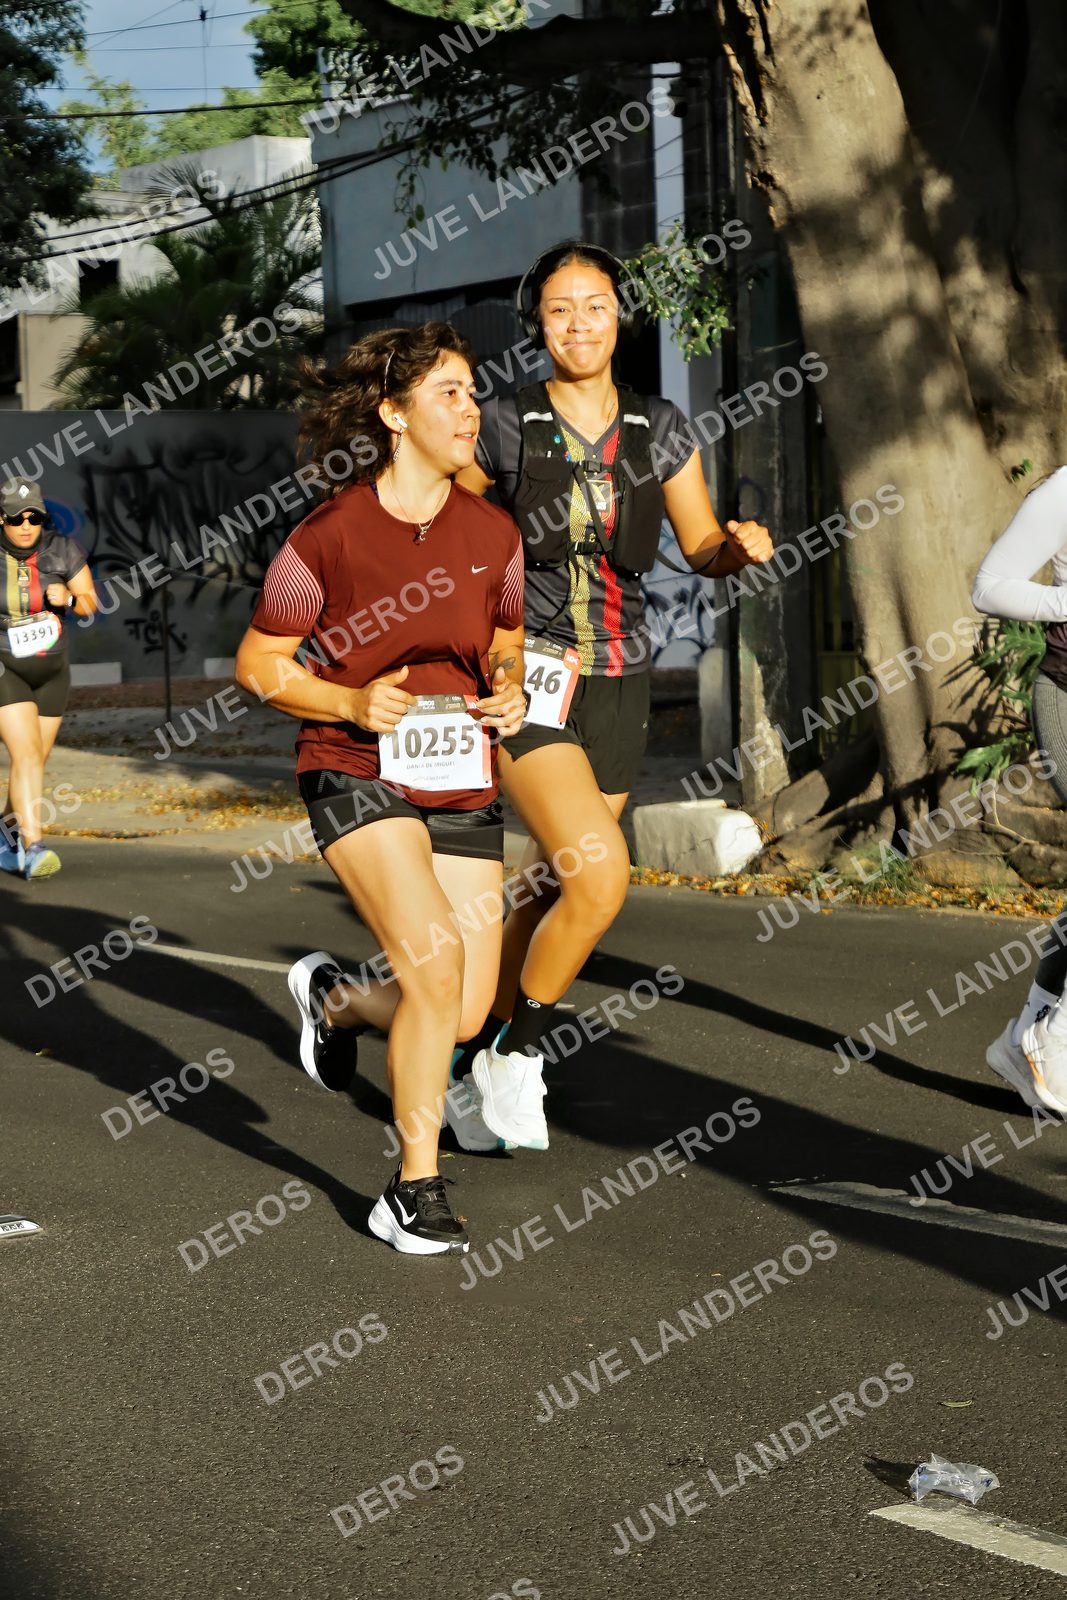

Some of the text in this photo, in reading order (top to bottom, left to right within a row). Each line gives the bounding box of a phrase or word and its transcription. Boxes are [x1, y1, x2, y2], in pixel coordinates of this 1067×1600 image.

[13, 625, 54, 645] 13391
[526, 665, 563, 695] 46
[384, 725, 475, 759] 10255
